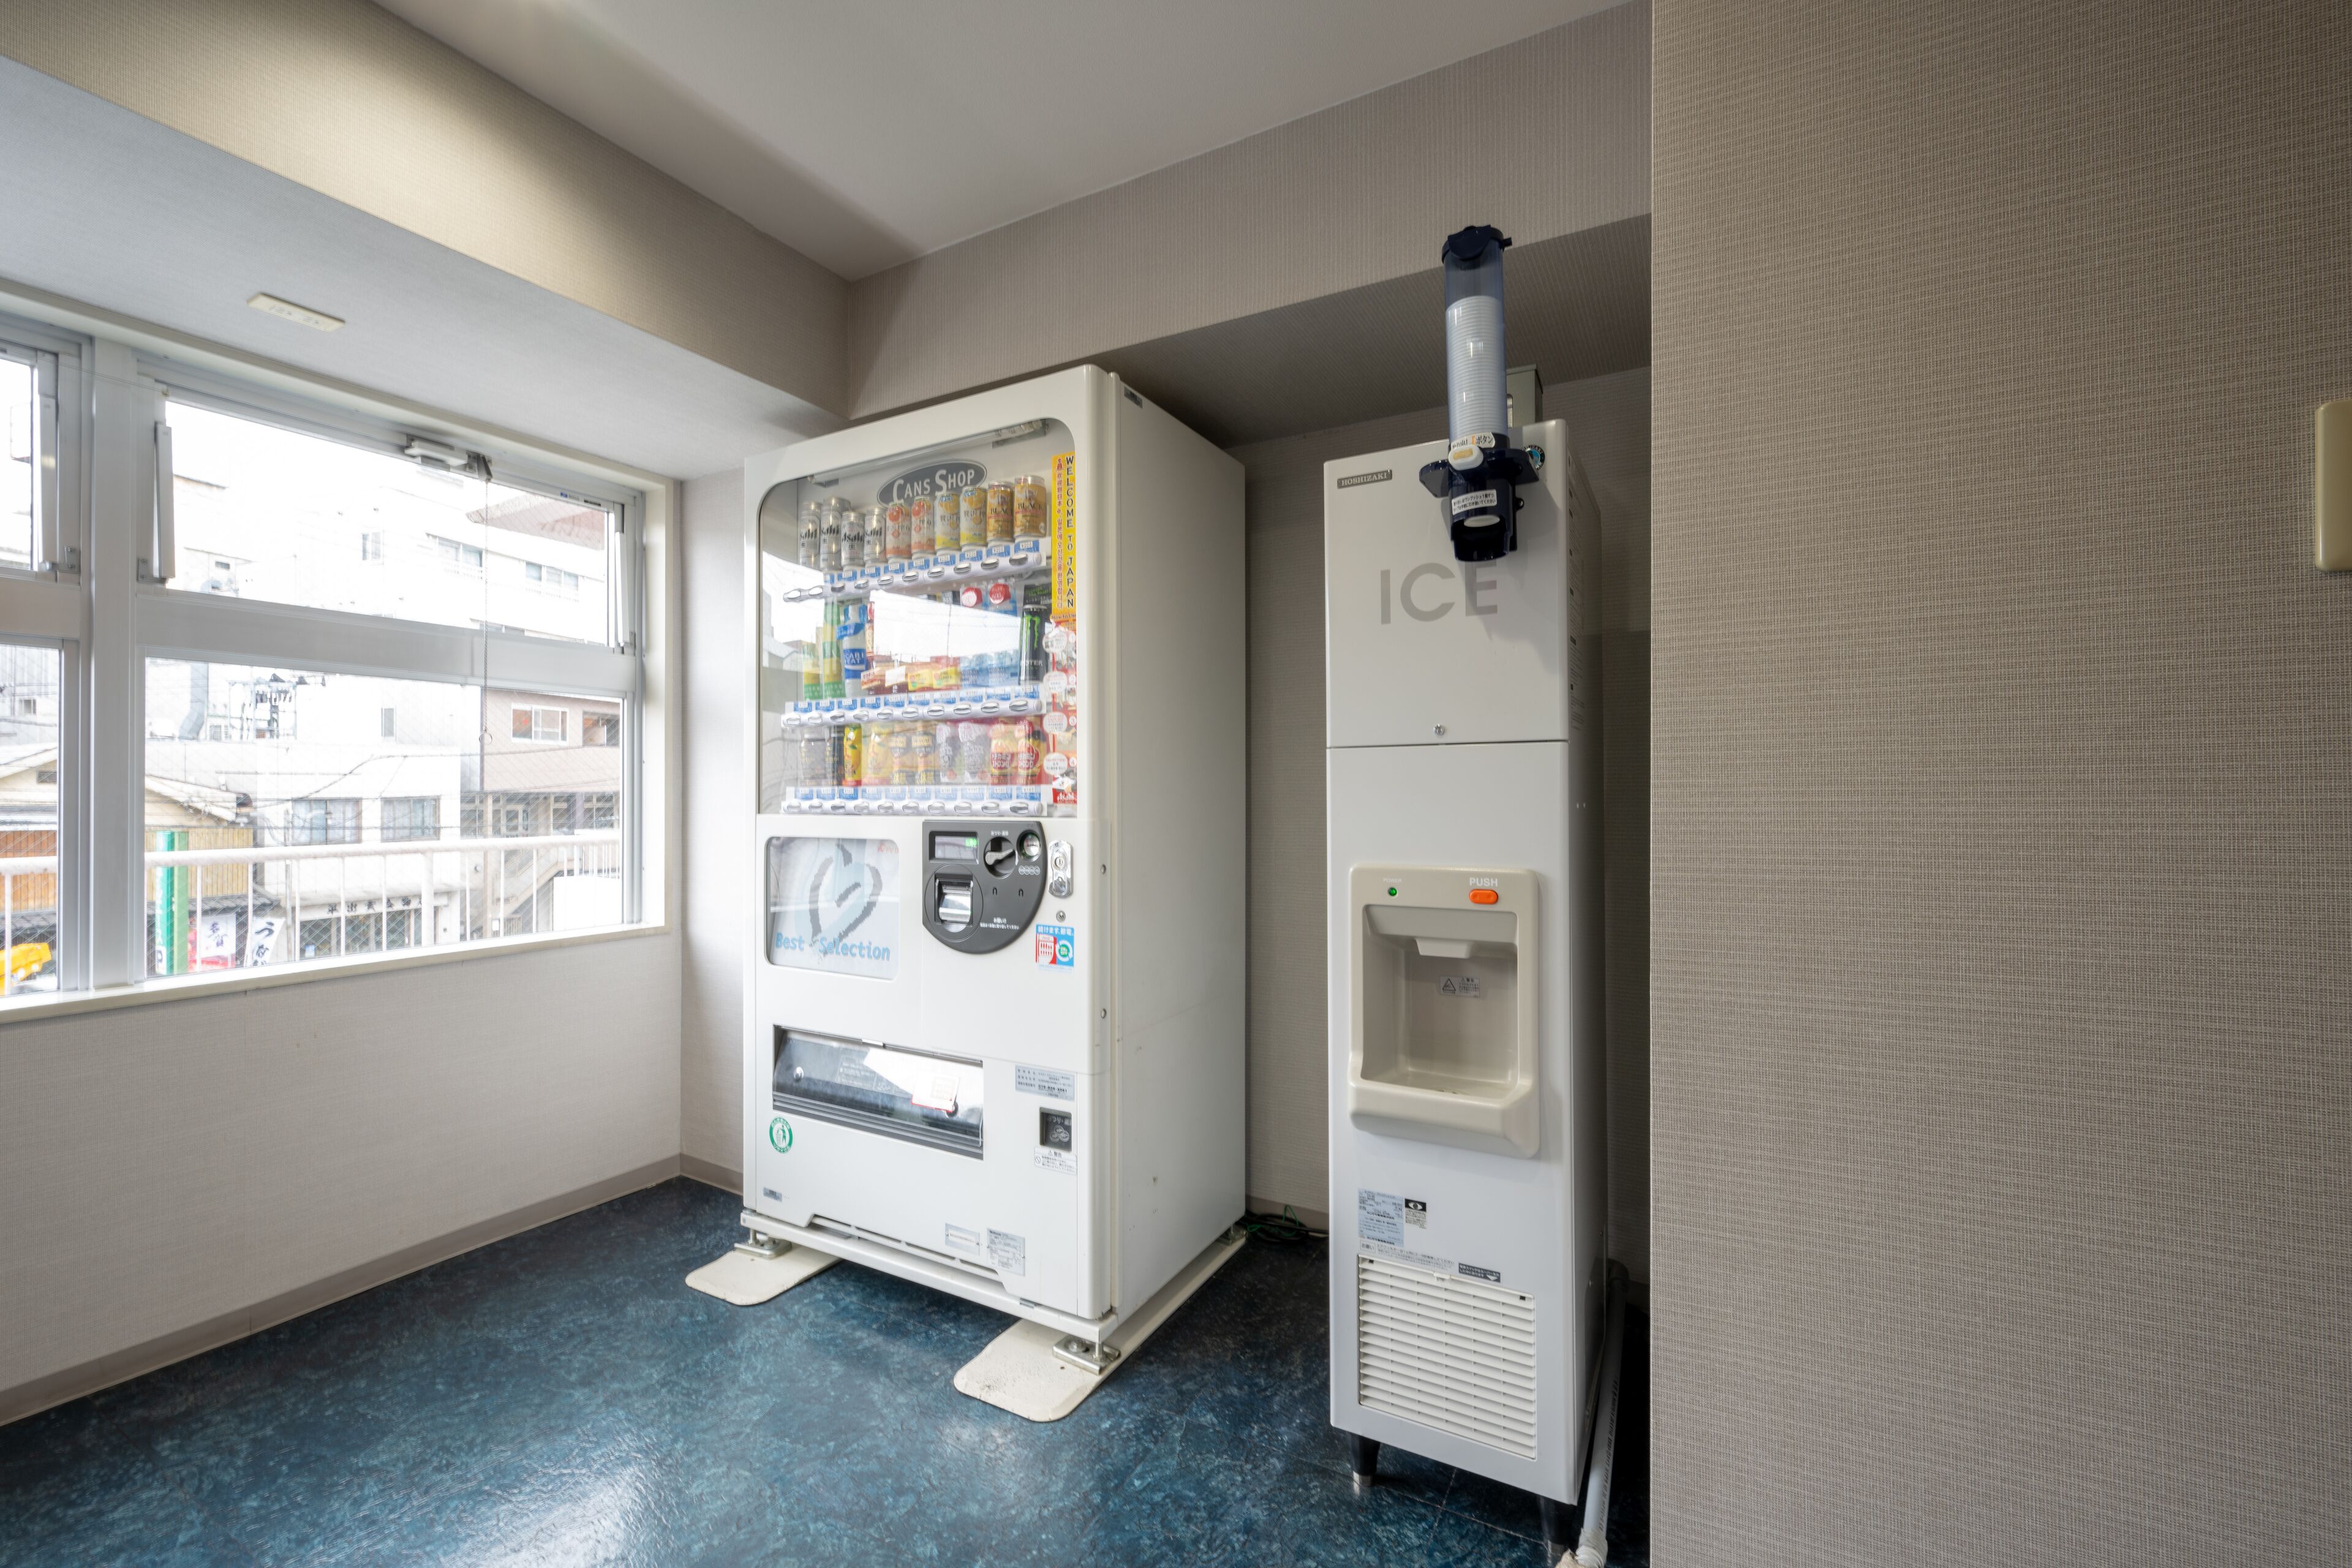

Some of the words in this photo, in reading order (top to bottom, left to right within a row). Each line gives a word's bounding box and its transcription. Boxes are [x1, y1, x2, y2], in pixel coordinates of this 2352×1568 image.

[893, 478, 930, 503] CANS
[935, 469, 975, 495] SHOP
[1341, 472, 1387, 486] HOSHIZAKI
[1067, 535, 1073, 551] TO
[1380, 559, 1498, 625] ICE
[1469, 878, 1498, 888] PUSH
[775, 931, 804, 951] Best
[818, 936, 891, 961] Selection
